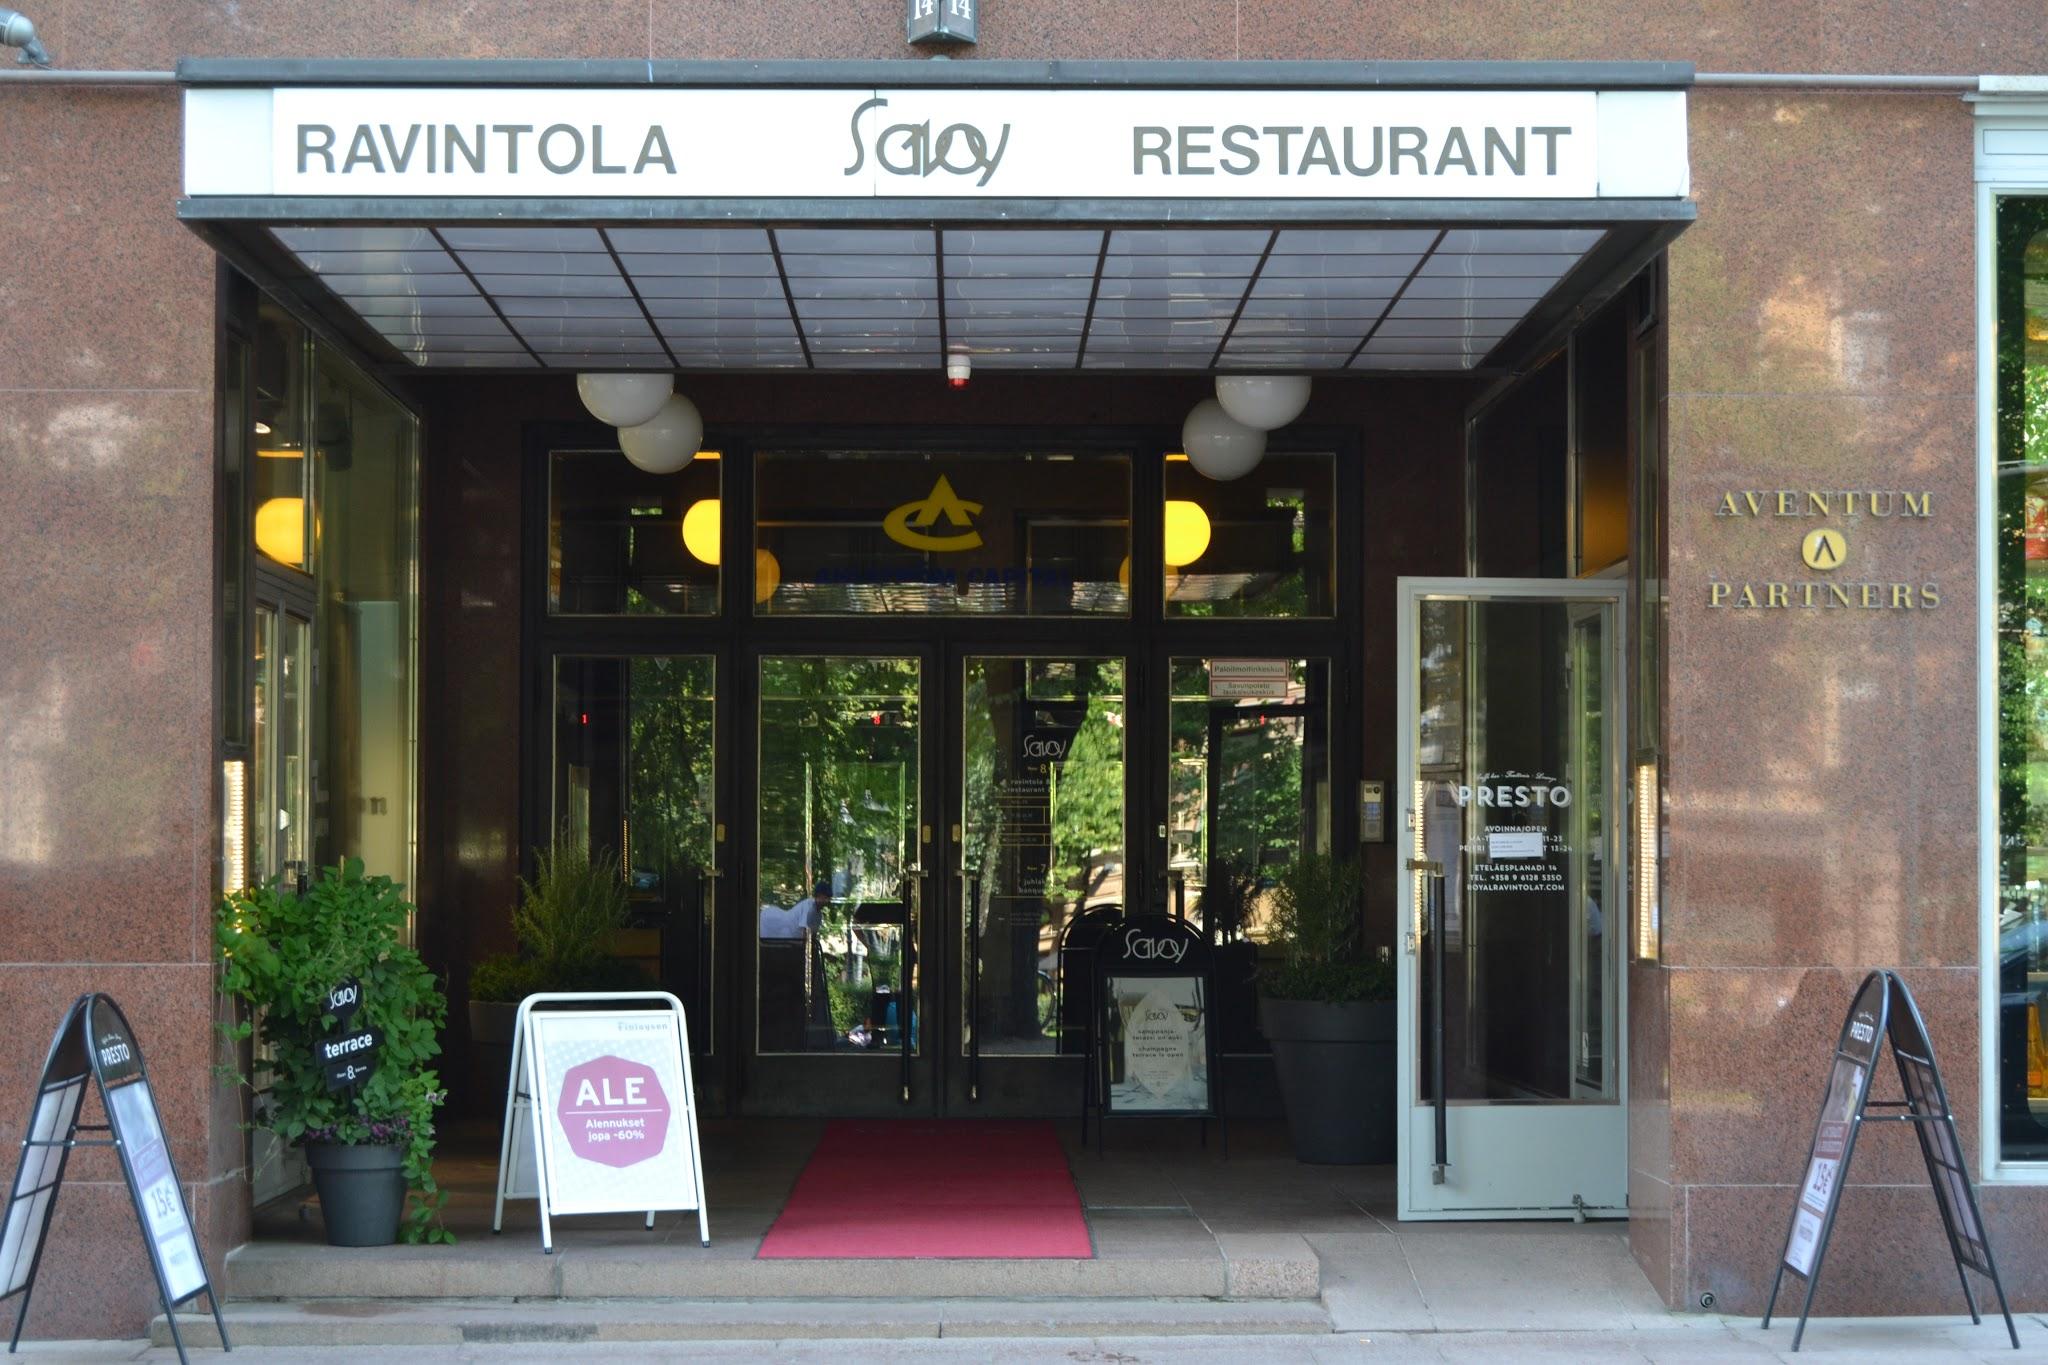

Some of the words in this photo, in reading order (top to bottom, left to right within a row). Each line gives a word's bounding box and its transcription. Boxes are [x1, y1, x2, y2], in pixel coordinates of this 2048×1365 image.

[297, 123, 677, 175] RAVINTOLA
[844, 97, 1011, 187] Savoy
[1133, 125, 1572, 177] RESTAURANT
[1714, 490, 1934, 517] AVENTUM
[1708, 581, 1941, 610] PARTNERS
[1022, 734, 1068, 759] Savoy
[1458, 785, 1572, 808] PRESTO
[1474, 863, 1545, 871] ETELÄESPLANADI
[1467, 883, 1565, 892] ROYALRAVINTOLAT.COM
[1122, 928, 1189, 964] Savoy
[1851, 1020, 1874, 1043] PRESTO
[101, 1043, 130, 1067] PRESTO
[324, 1033, 373, 1059] terrace
[575, 1076, 648, 1107] ALE
[585, 1118, 645, 1129] Alennukset
[588, 1131, 611, 1142] jopa
[613, 1130, 645, 1140] -60%
